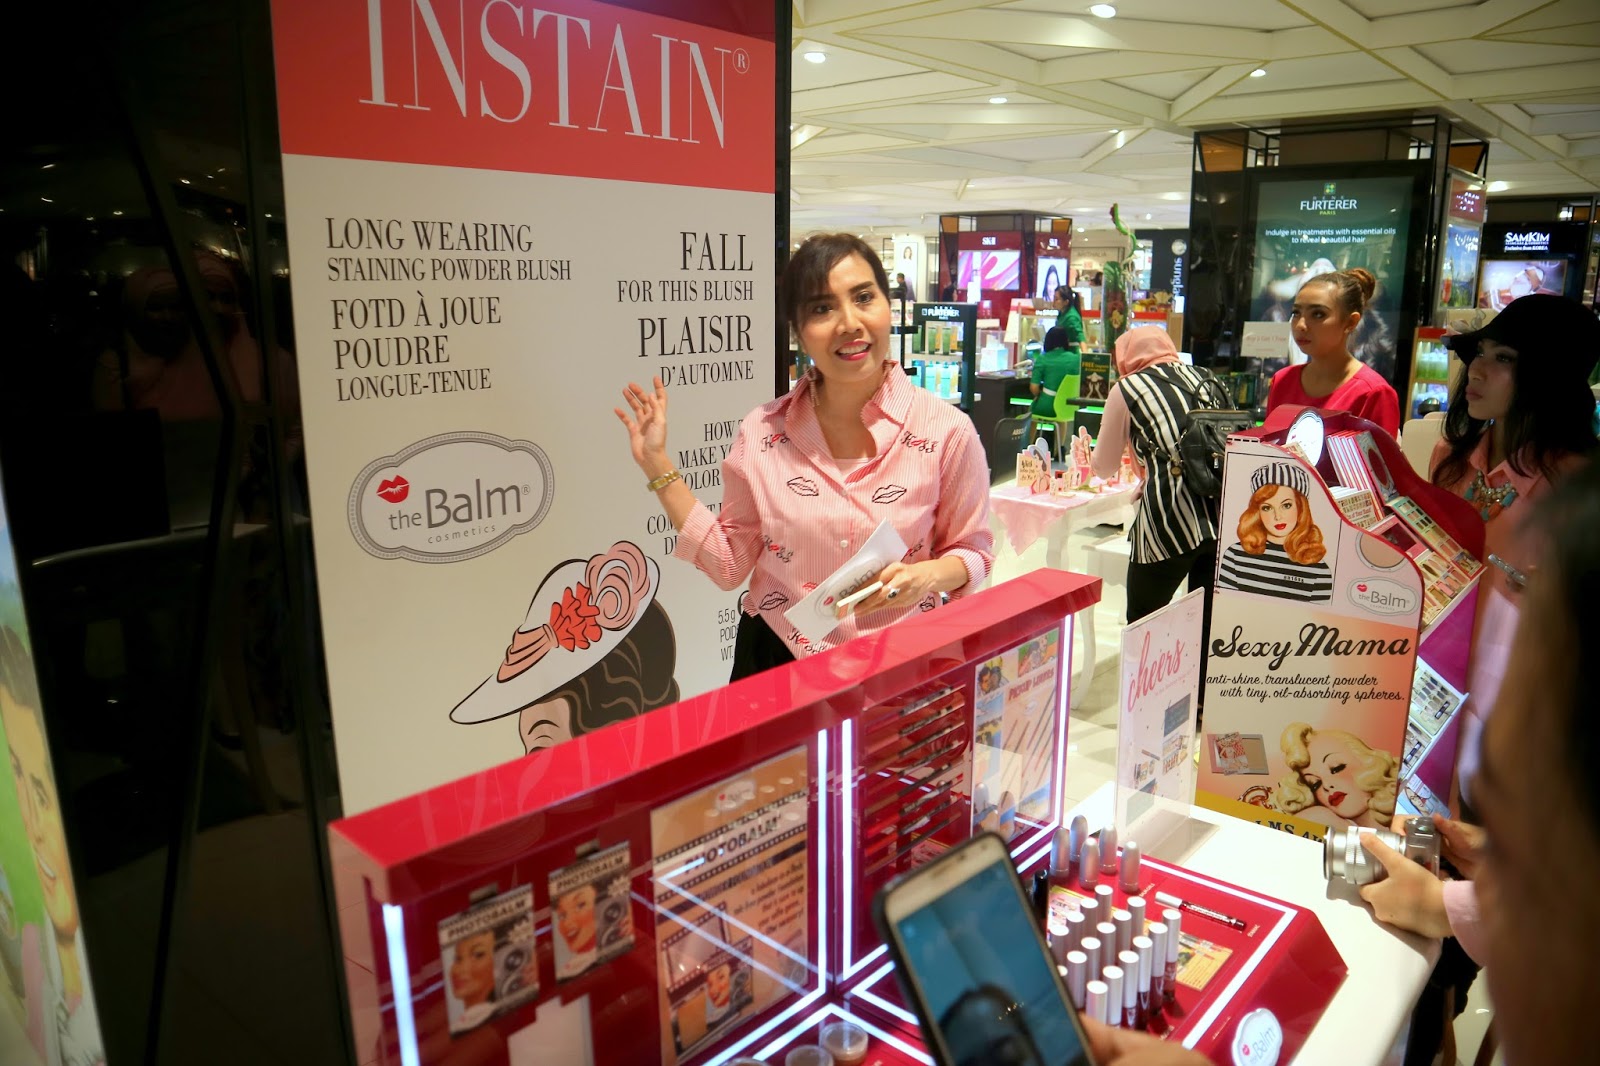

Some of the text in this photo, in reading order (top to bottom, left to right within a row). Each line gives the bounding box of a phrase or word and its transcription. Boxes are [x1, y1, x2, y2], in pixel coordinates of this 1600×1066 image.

[1300, 200, 1358, 210] FURTERER
[325, 217, 533, 253] LONG WEARING
[1265, 229, 1289, 237] Indulge
[1298, 228, 1334, 236] treatments
[1383, 227, 1397, 235] oils
[1300, 236, 1320, 244] reveal
[680, 231, 754, 273] FALL
[327, 257, 572, 283] STAINING POWDER BLUSH
[617, 280, 754, 303] FOR THIS BLUSH
[331, 297, 406, 331] FOTD
[440, 296, 502, 327] JOUE
[637, 314, 754, 359] PLAISIR
[334, 335, 450, 371] POUDRE
[336, 368, 492, 403] LONGUE-TENUE
[704, 420, 735, 442] HOW
[678, 446, 717, 469] MAKE
[428, 524, 496, 545] cosmetics
[1208, 623, 1412, 671] Sexy Mama
[1127, 630, 1186, 713] cheers
[1265, 674, 1331, 687] translucent
[1333, 674, 1378, 692] powder
[1219, 687, 1244, 698] with
[1273, 687, 1351, 705] oil-absorbing
[1354, 688, 1406, 705] spheres.
